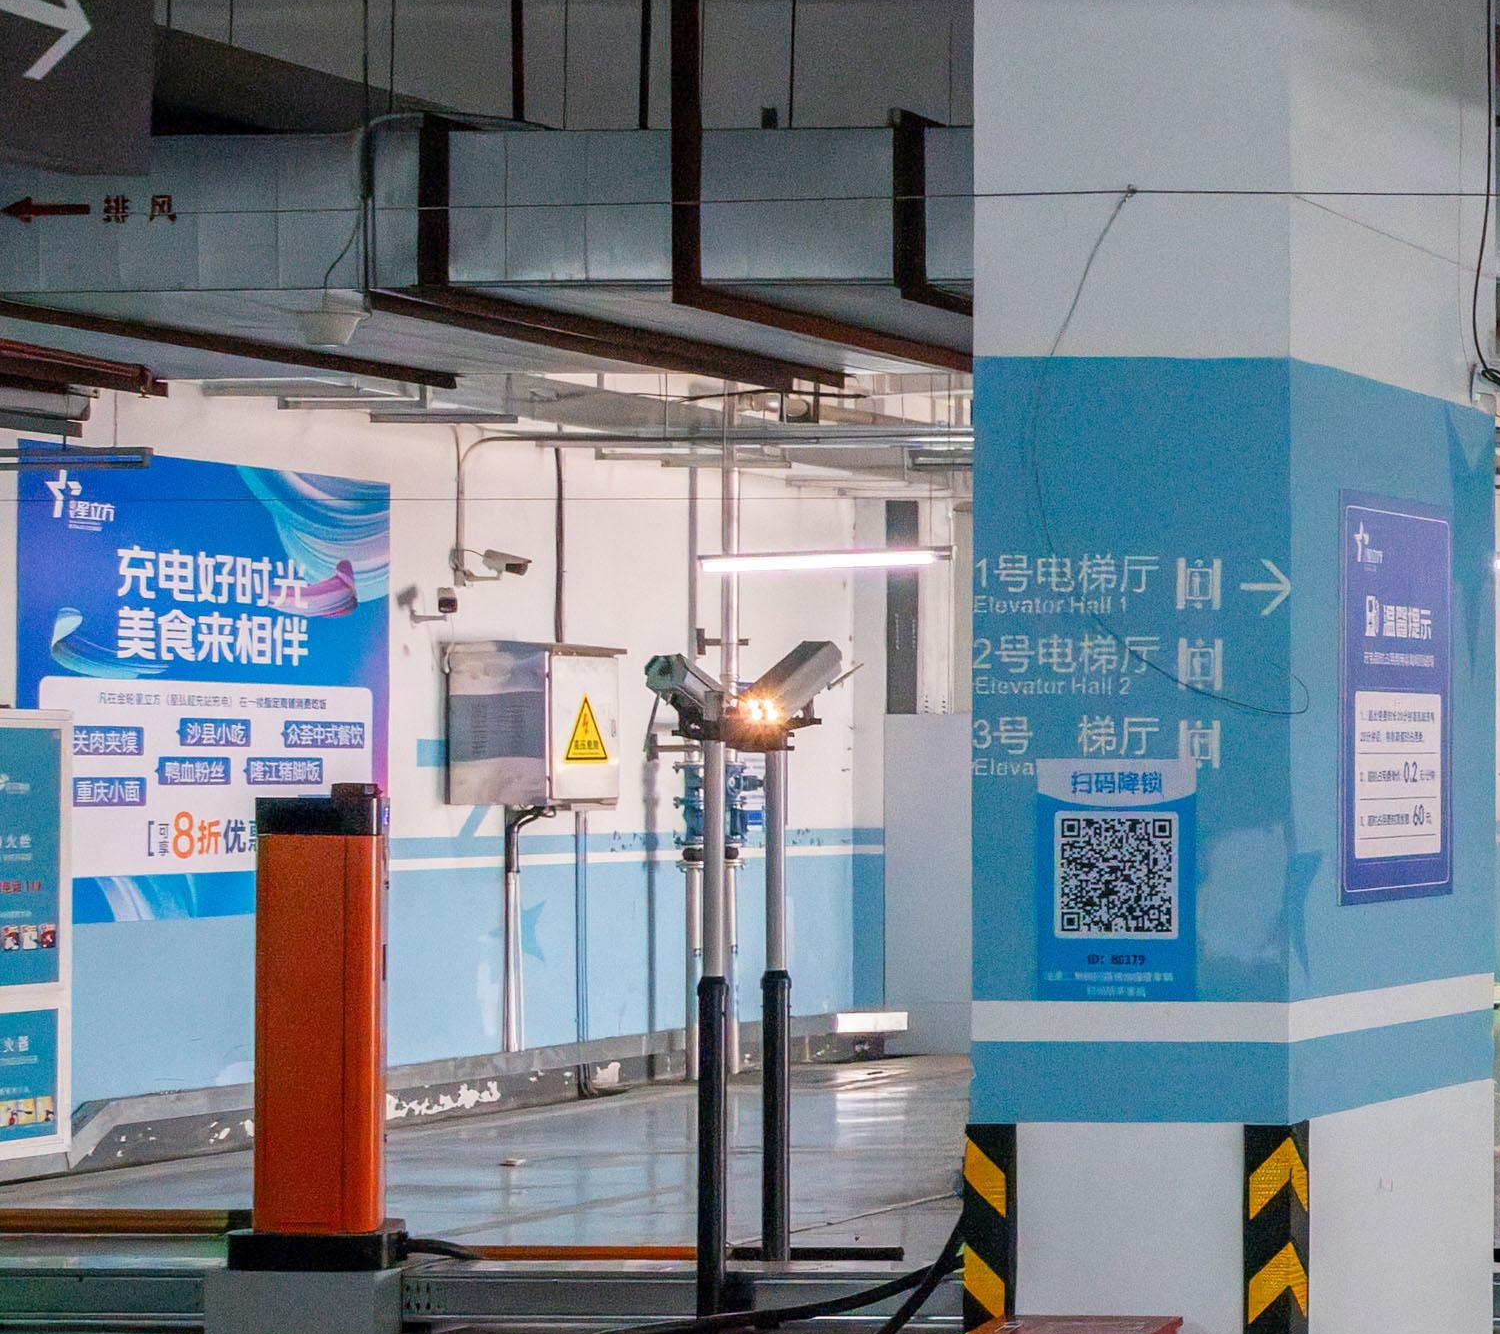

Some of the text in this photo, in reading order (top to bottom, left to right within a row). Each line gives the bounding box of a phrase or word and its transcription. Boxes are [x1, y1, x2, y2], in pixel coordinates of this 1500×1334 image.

[116, 545, 309, 609] 充电好时光
[974, 553, 1161, 594] 1号电梯厅
[116, 605, 309, 667] 美食来相伴
[971, 633, 1161, 676] 2号电梯厅
[1118, 678, 1131, 695] 2
[185, 721, 247, 745] 沙县小吃
[164, 760, 226, 784] 鸭血粉丝
[1071, 771, 1163, 795] 扫码降锁
[75, 780, 141, 804] 重庆小面
